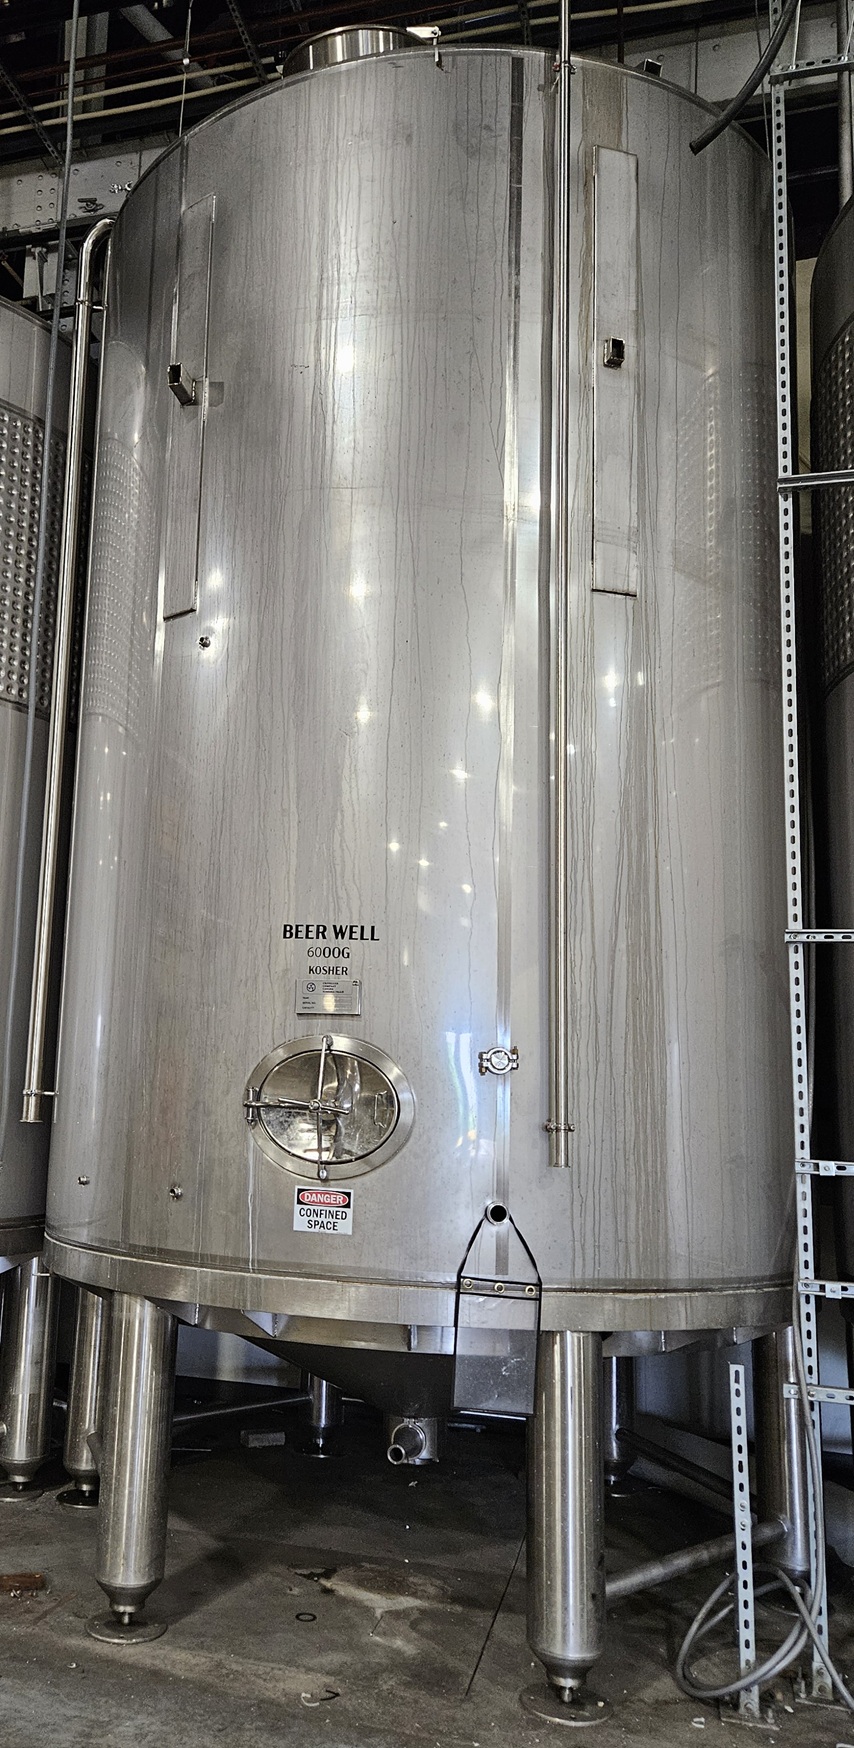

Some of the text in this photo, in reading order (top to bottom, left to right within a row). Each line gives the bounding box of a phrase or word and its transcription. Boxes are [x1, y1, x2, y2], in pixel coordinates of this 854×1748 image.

[283, 924, 380, 941] BEER WELL
[307, 947, 350, 959] 6000G
[308, 966, 348, 976] KOSHER
[304, 1193, 344, 1204] DANGER
[299, 1207, 347, 1220] CONFINED
[307, 1219, 338, 1231] SPACE
